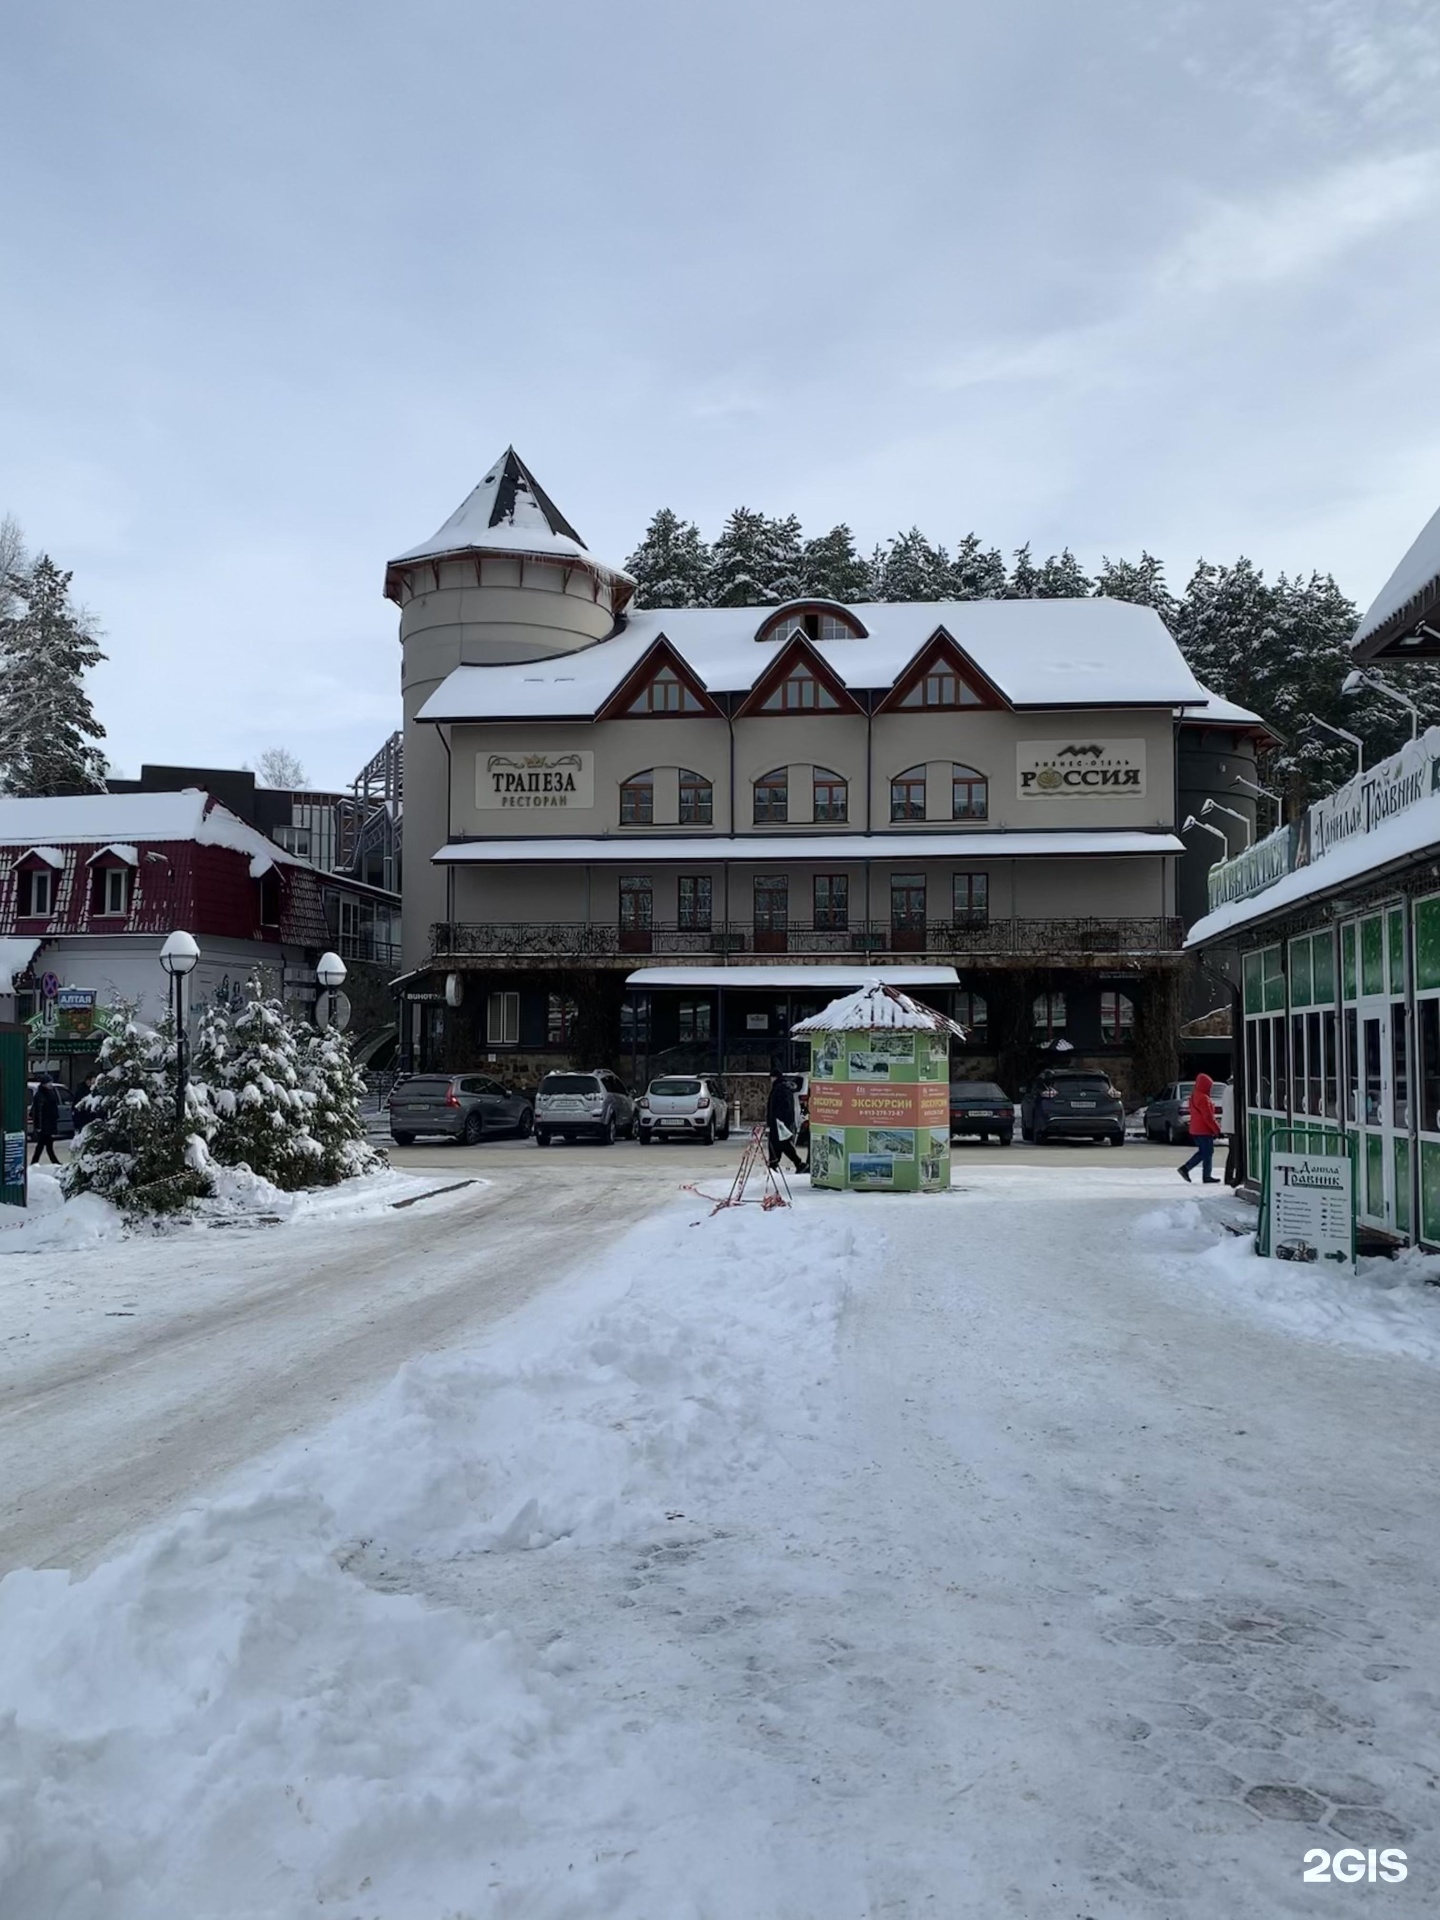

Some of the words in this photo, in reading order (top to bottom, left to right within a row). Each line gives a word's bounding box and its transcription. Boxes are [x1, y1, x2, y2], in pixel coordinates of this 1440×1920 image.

[492, 772, 577, 792] ТРАПЕЗА
[1020, 767, 1141, 789] РОССИЯ
[502, 796, 568, 807] РЕСТОРАН
[851, 1098, 912, 1109] ЭКСКУРСИИ
[1273, 1165, 1341, 1187] Травник
[1300, 1161, 1340, 1175] Данила
